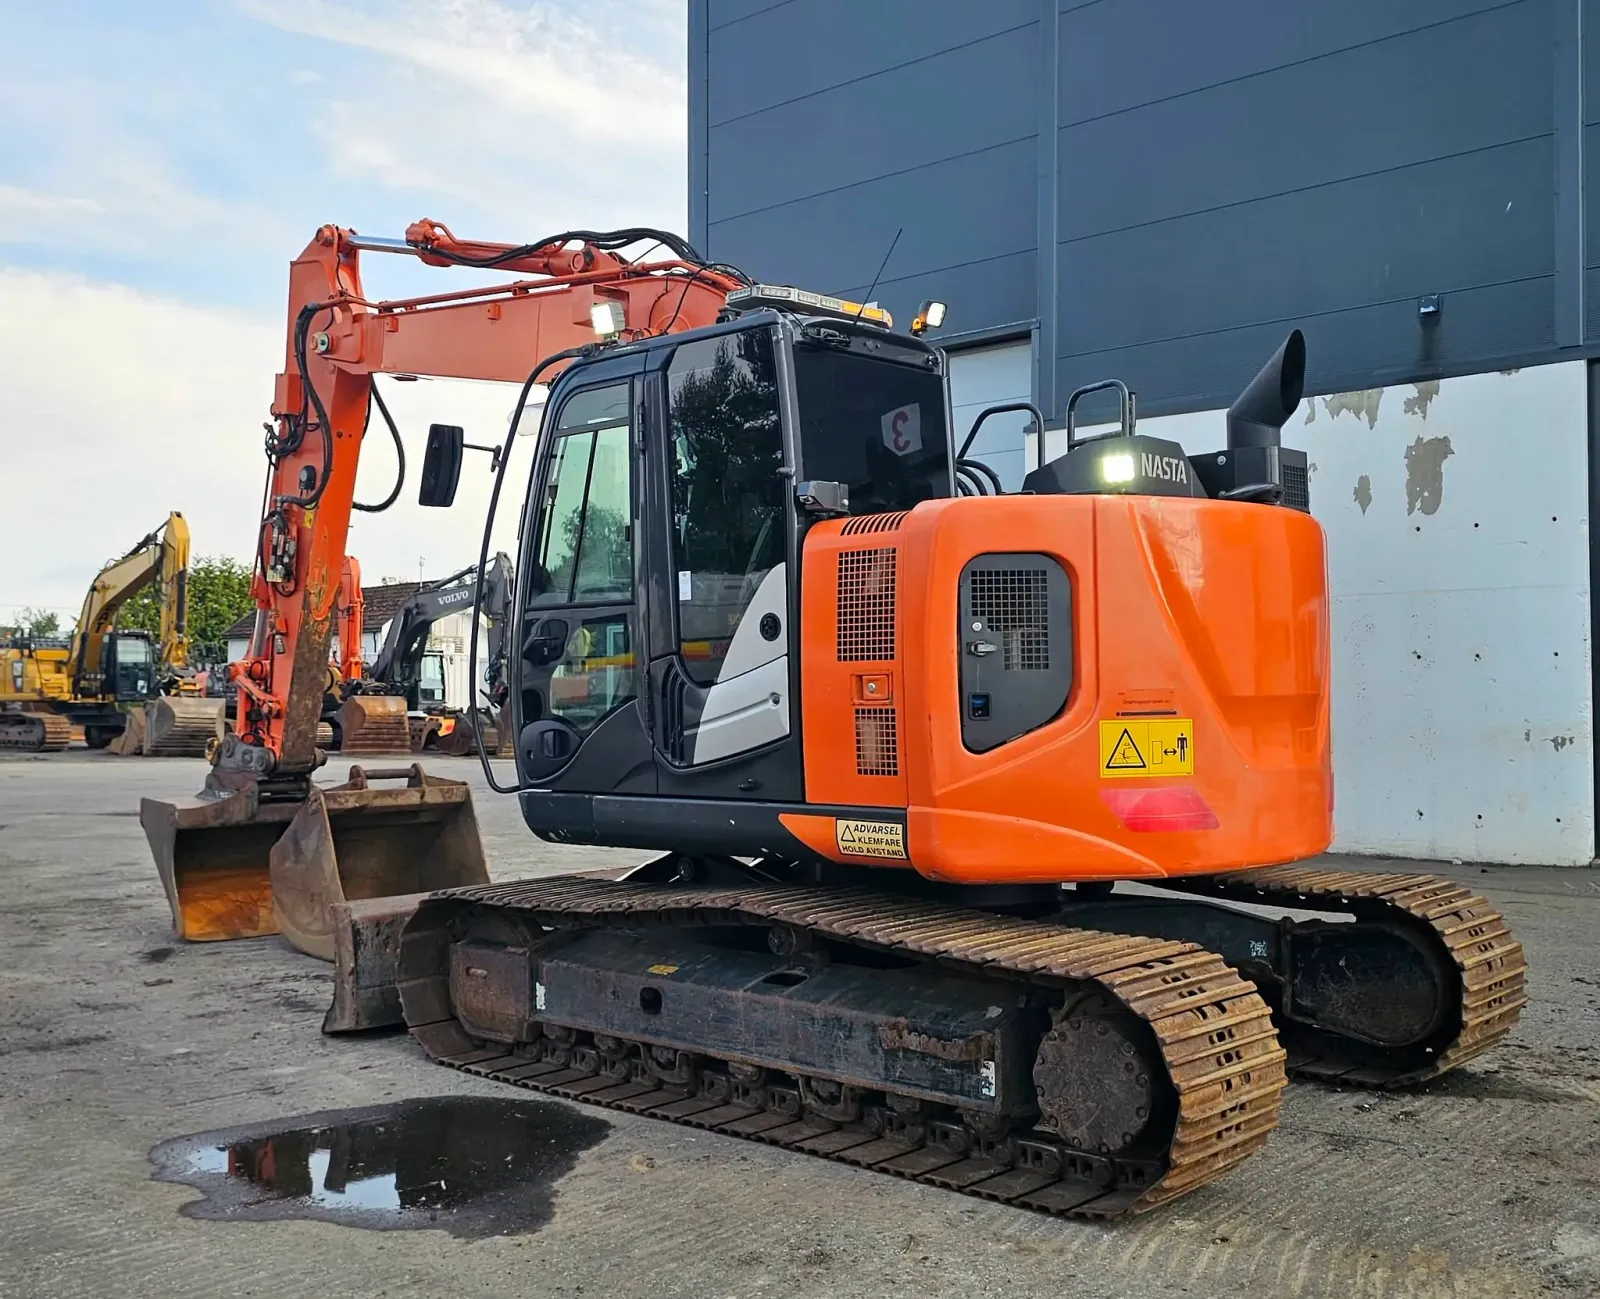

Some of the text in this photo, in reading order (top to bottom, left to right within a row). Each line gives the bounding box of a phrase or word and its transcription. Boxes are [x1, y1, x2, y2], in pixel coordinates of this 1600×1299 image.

[1141, 452, 1187, 484] NASTA
[438, 590, 469, 605] VOLVO
[854, 824, 900, 836] ADVARSEL
[858, 836, 901, 847] KLEMFARE
[842, 845, 904, 857] HOLD AVSTAND
